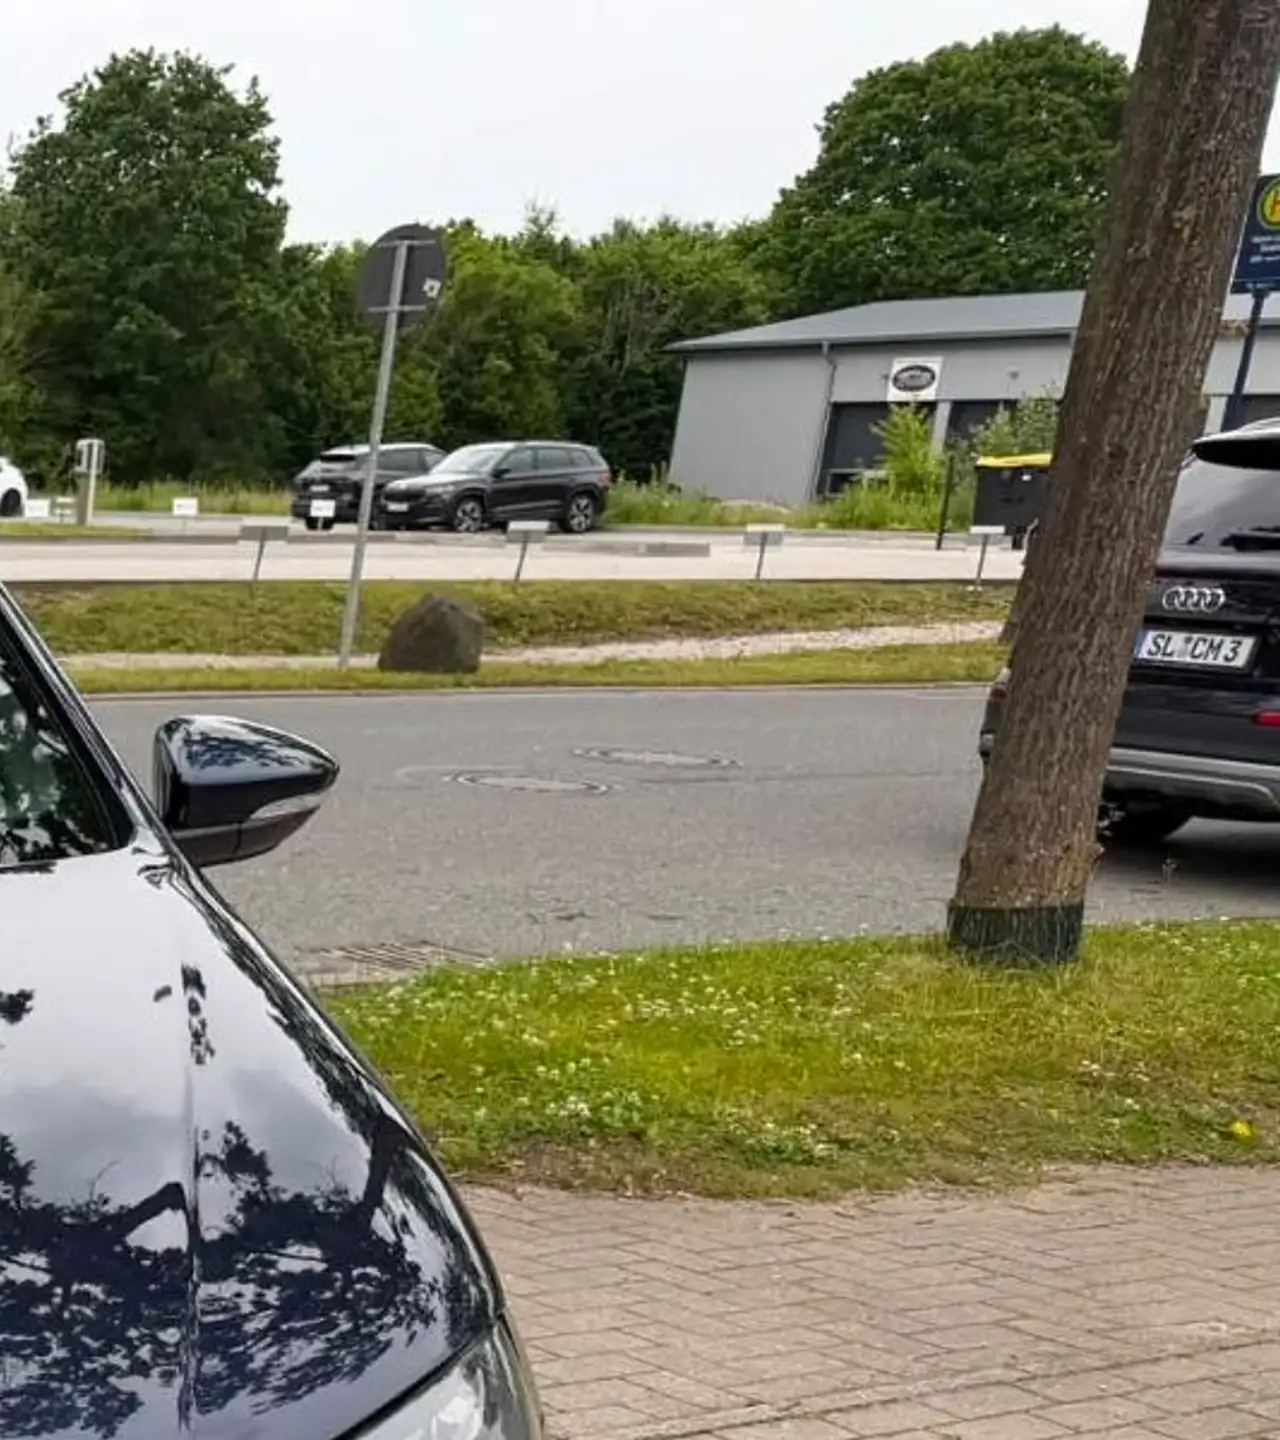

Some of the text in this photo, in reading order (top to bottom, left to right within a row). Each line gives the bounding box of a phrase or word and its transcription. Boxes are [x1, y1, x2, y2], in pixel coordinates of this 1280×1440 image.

[1147, 633, 1243, 663] SL CM 3
